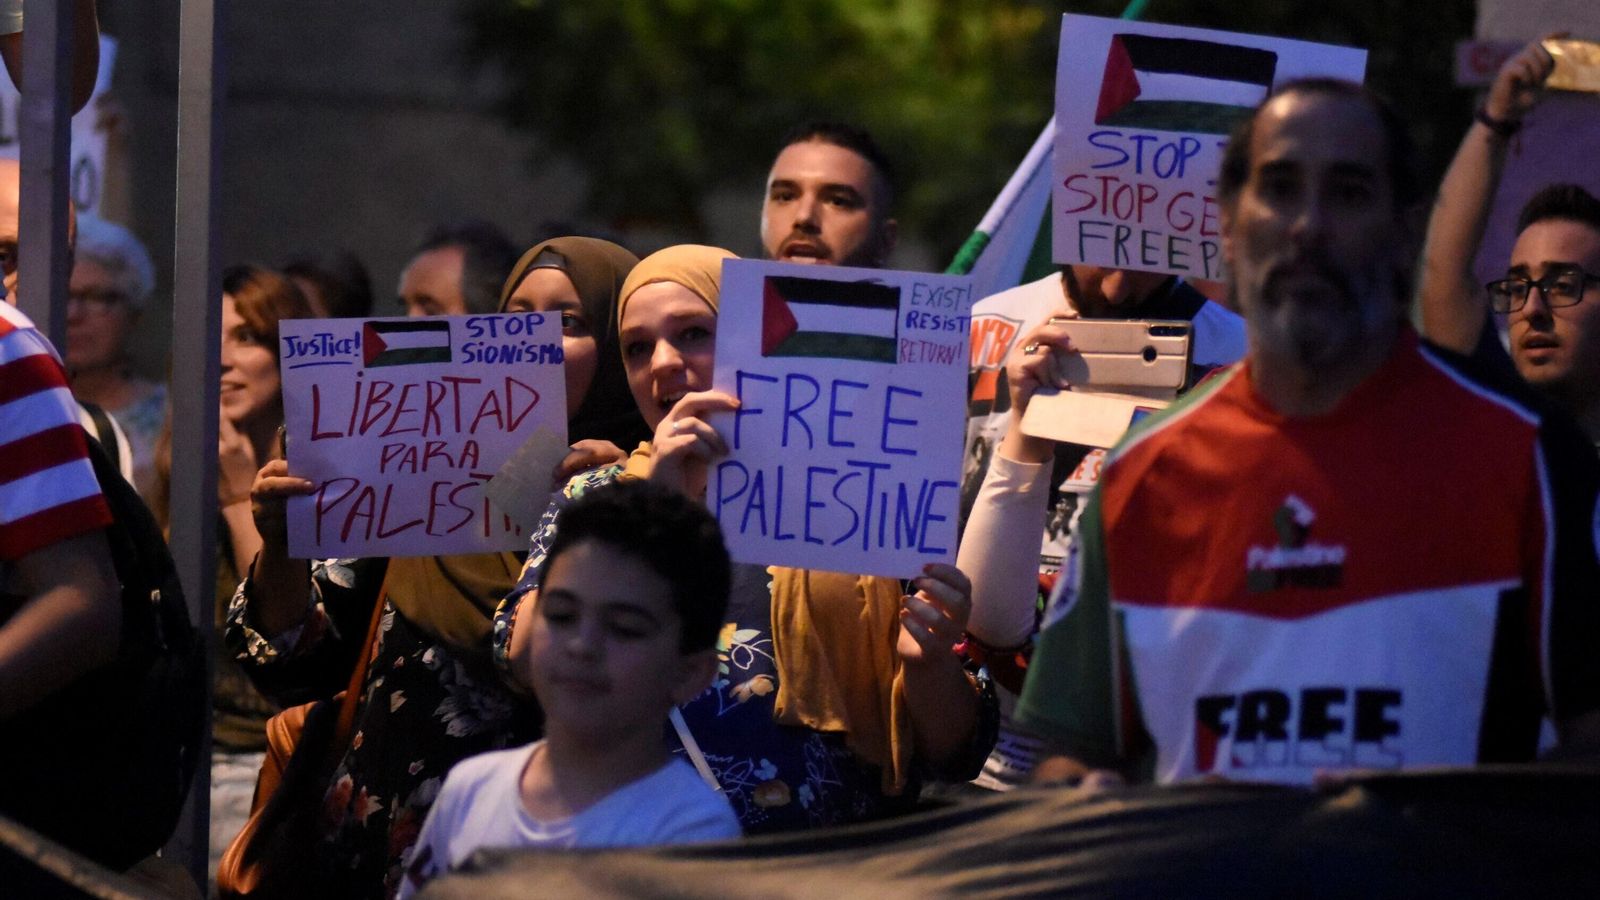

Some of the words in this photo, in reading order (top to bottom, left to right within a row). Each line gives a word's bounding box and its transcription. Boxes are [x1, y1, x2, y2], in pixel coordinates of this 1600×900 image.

[1087, 130, 1201, 179] STOP
[1063, 173, 1159, 223] STOP
[1166, 191, 1219, 237] GE
[465, 313, 545, 339] STOP
[899, 337, 963, 365] RETURN!
[734, 370, 923, 456] FREE
[380, 439, 480, 474] PARA
[1194, 687, 1403, 772] FREE
